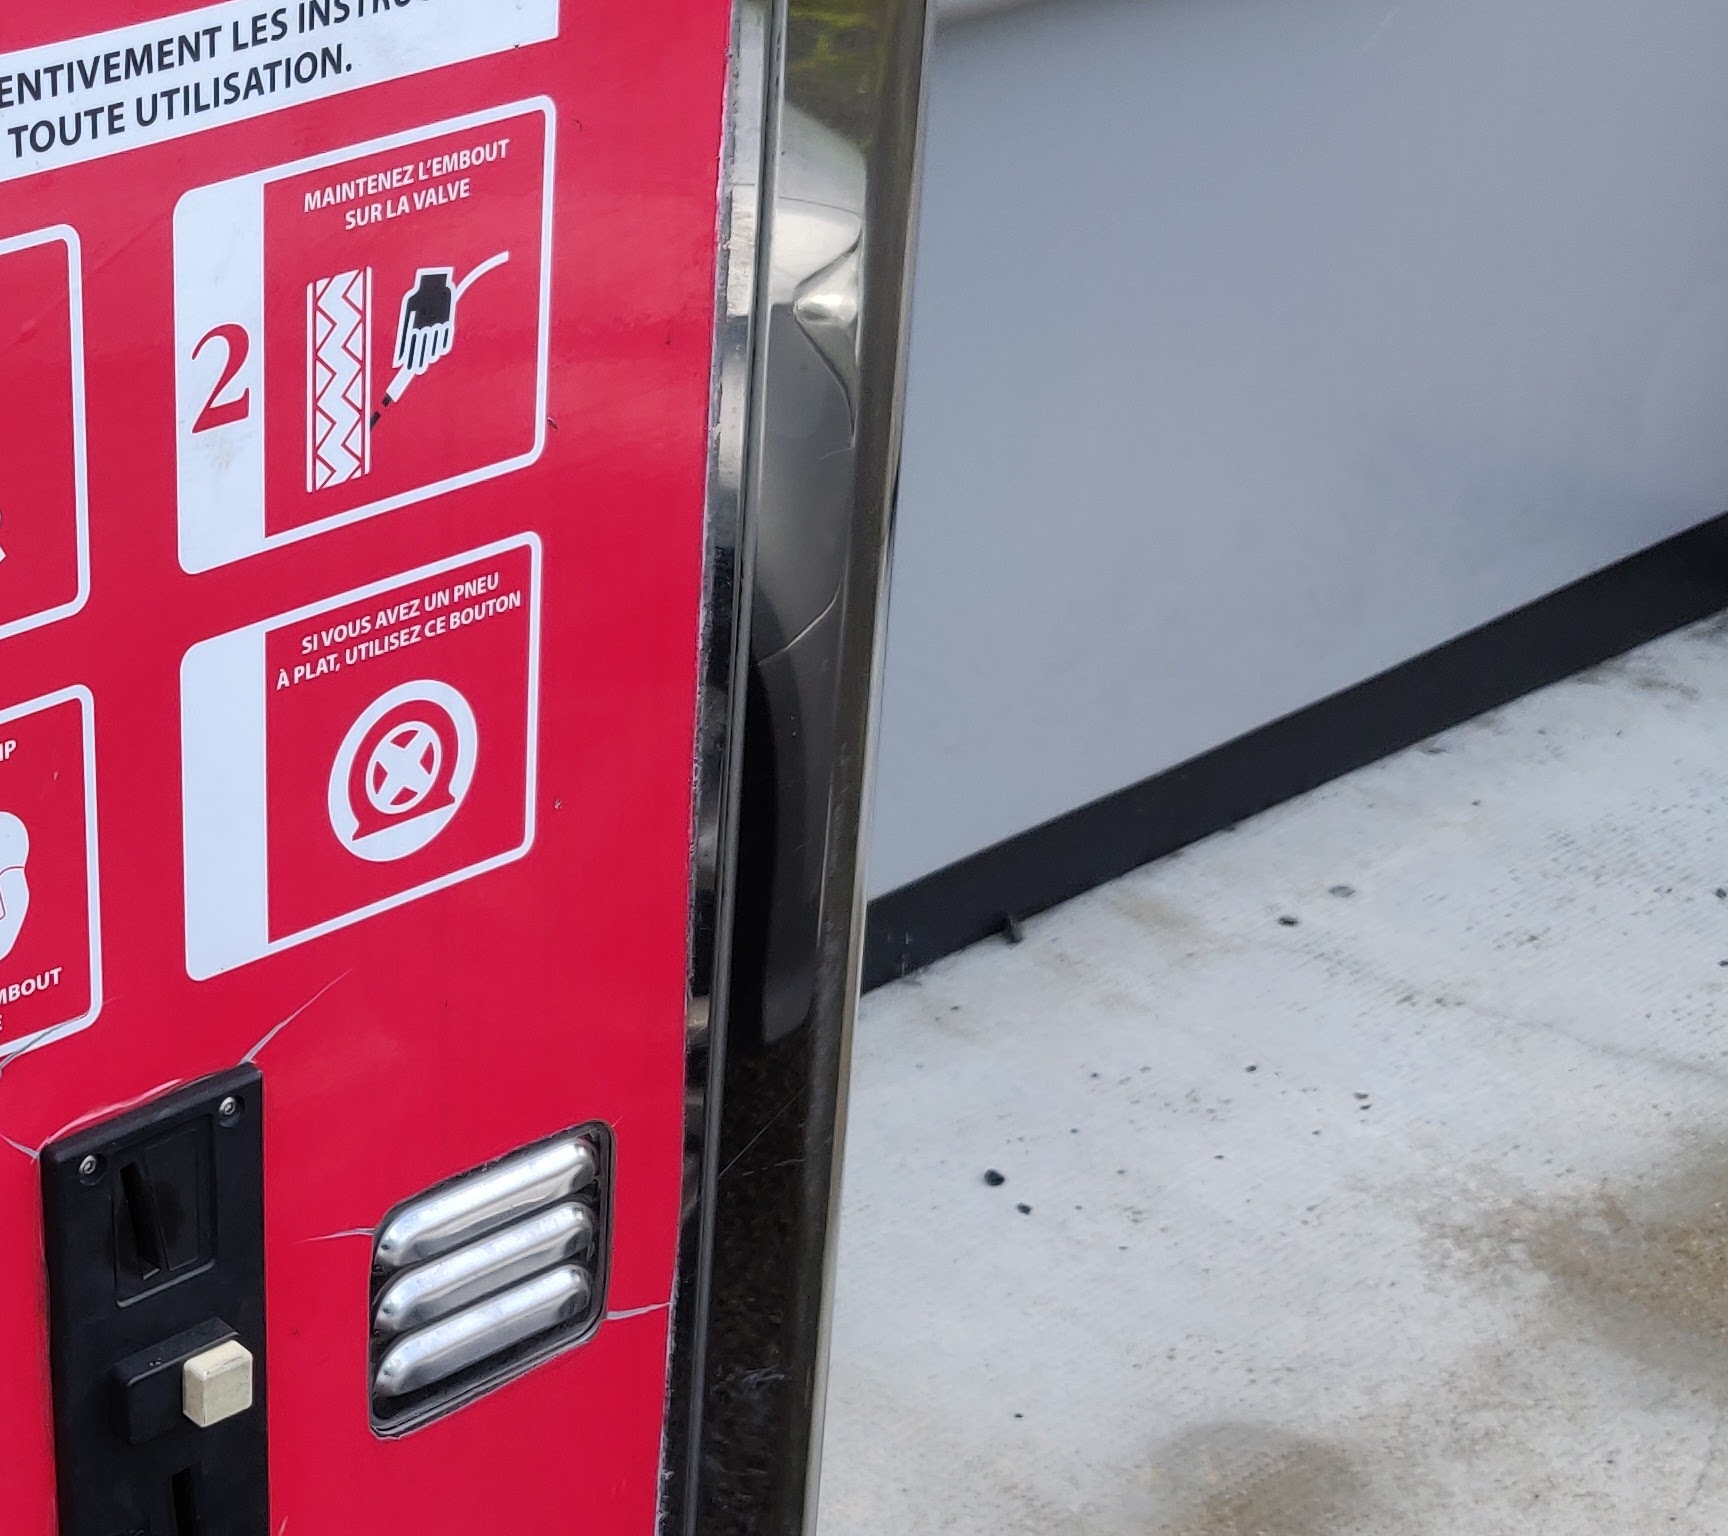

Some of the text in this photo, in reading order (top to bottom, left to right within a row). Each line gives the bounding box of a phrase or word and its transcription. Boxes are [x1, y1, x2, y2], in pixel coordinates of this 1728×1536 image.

[232, 7, 288, 52] LES
[6, 100, 125, 158] TOUTE
[135, 42, 352, 127] UTILISATION.
[303, 138, 510, 212] MAINTENEZ L'EMBOUT
[344, 177, 469, 230] SUR LA VALVE
[192, 324, 249, 433] 2
[276, 589, 521, 690] À PLAT, UTILISEZ CE BOUTON
[301, 571, 499, 654] SI VOUS AVEZ UN PNEU
